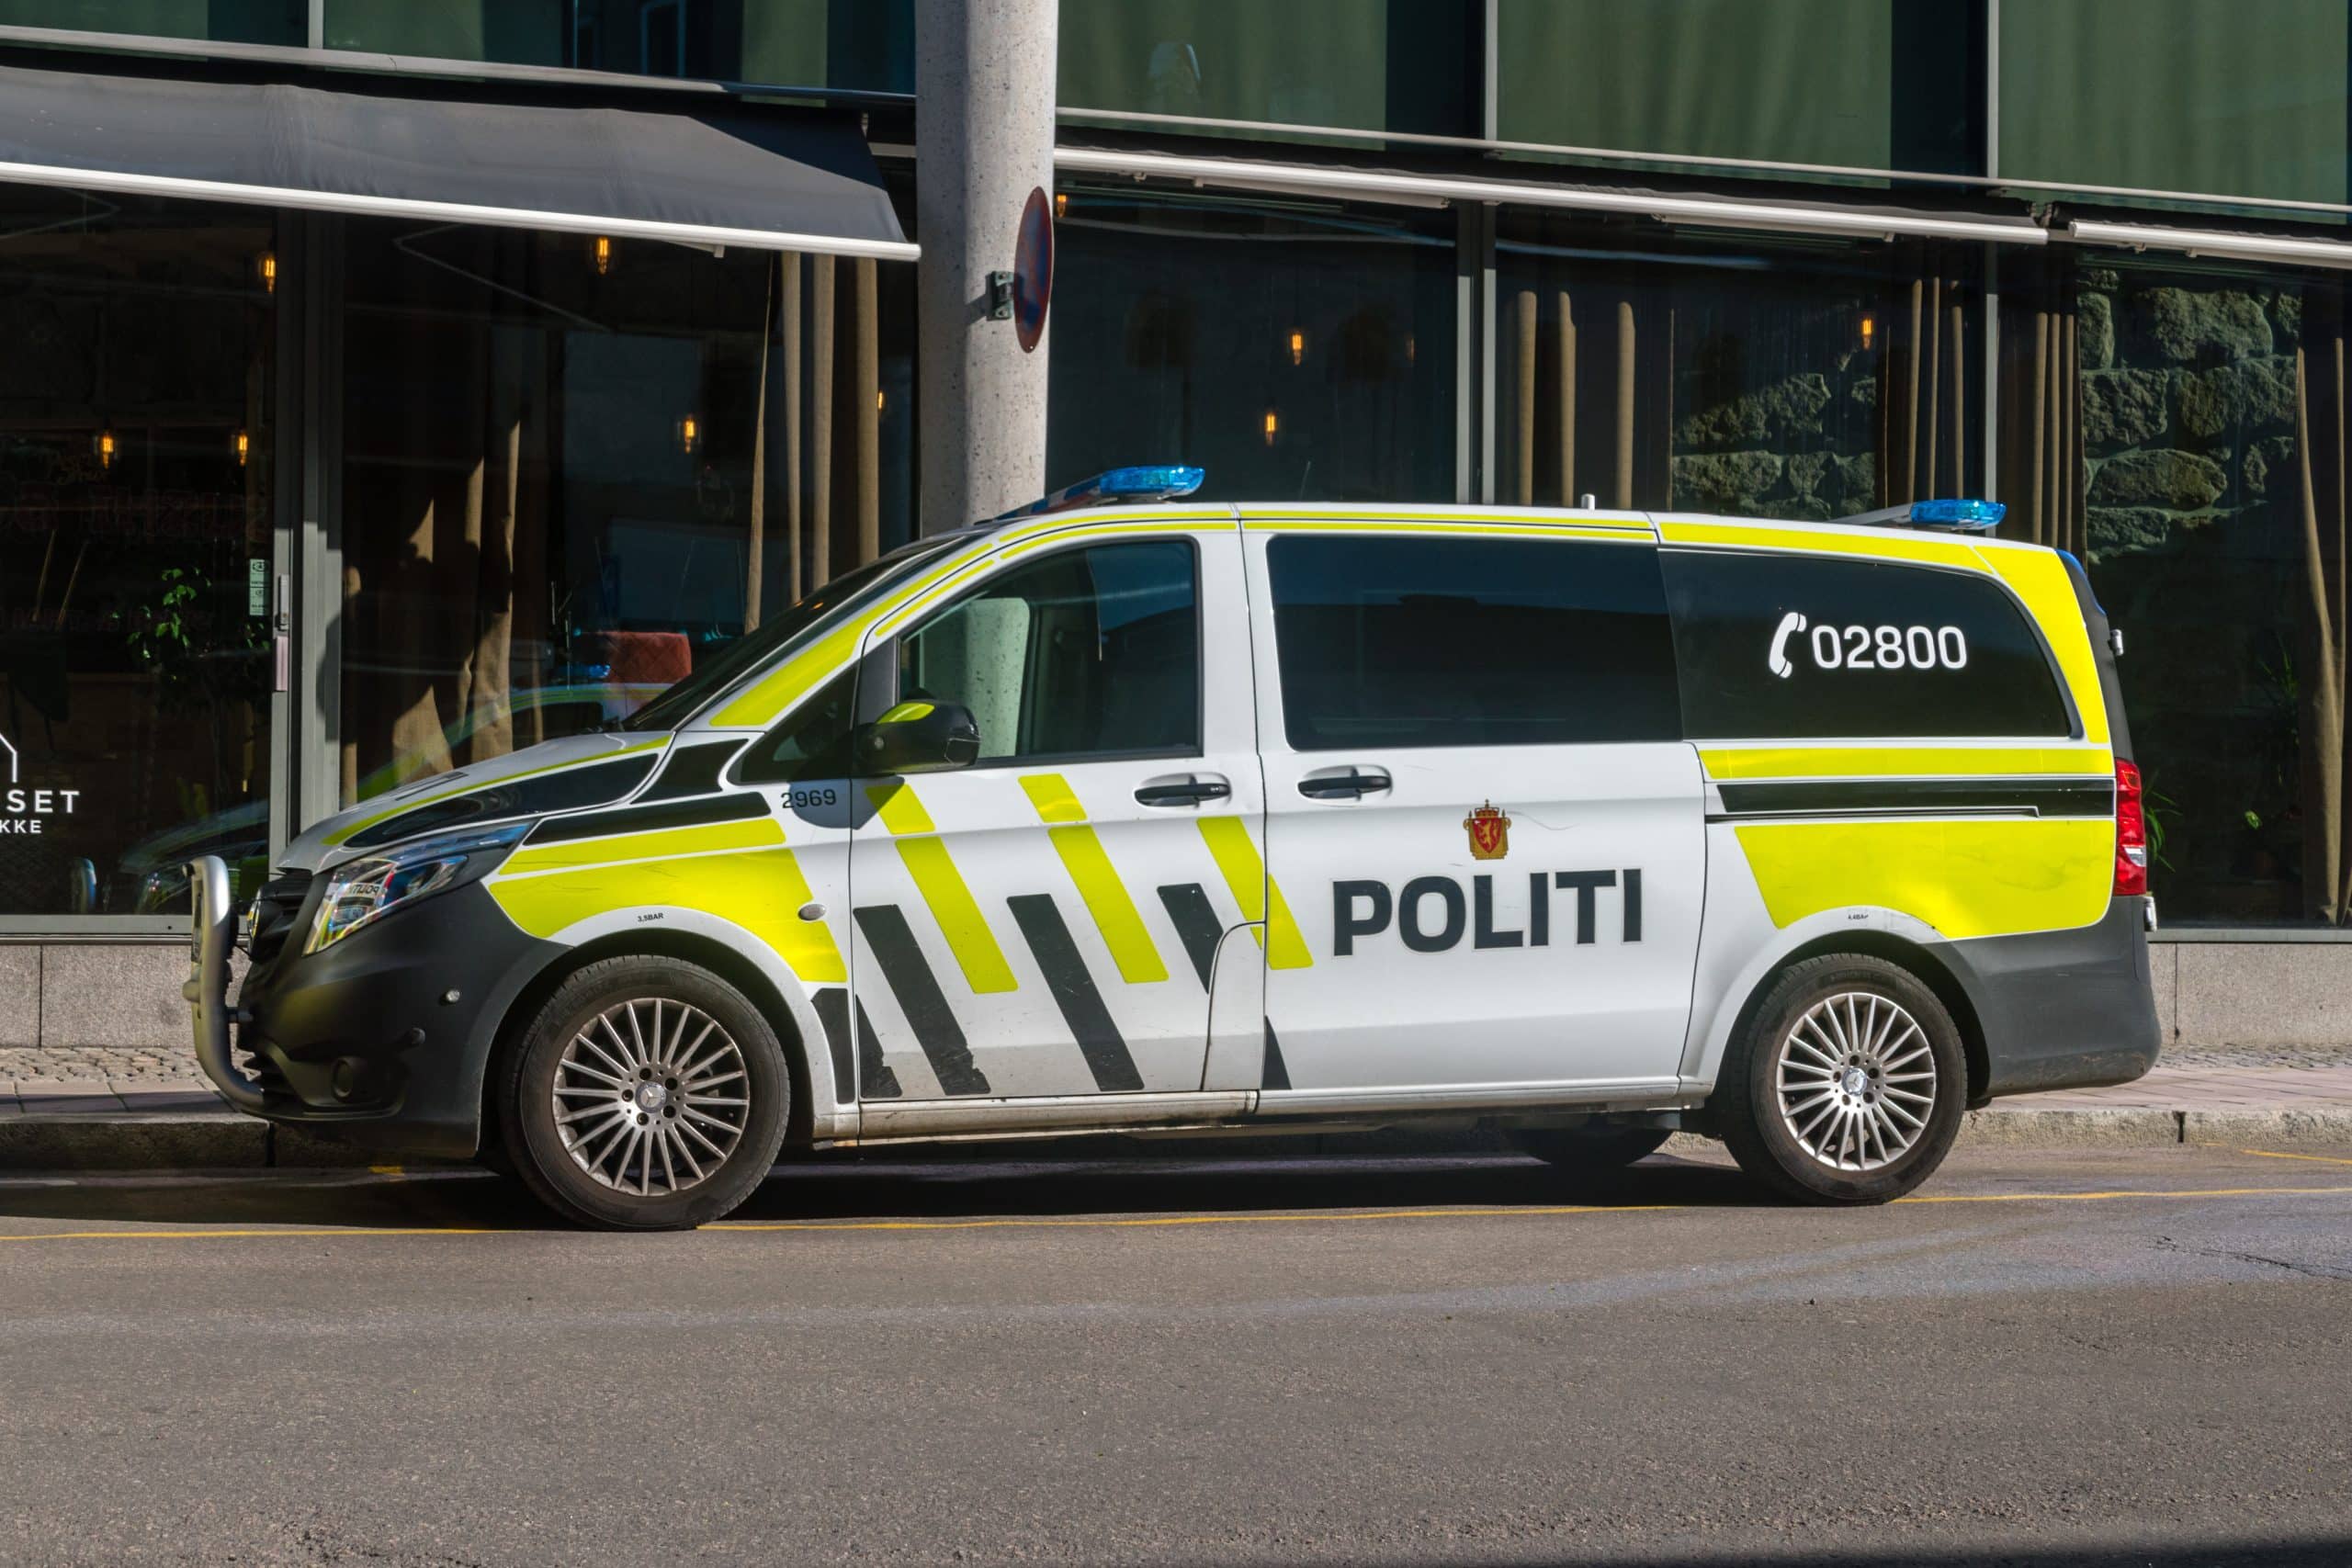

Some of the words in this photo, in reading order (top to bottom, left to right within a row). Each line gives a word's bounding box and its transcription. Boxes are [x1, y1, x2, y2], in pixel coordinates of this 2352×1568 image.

[1812, 625, 1967, 669] 02800
[6, 789, 80, 814] SET
[780, 788, 837, 809] 2969
[0, 819, 42, 833] KKE
[1332, 868, 1642, 957] POLITI
